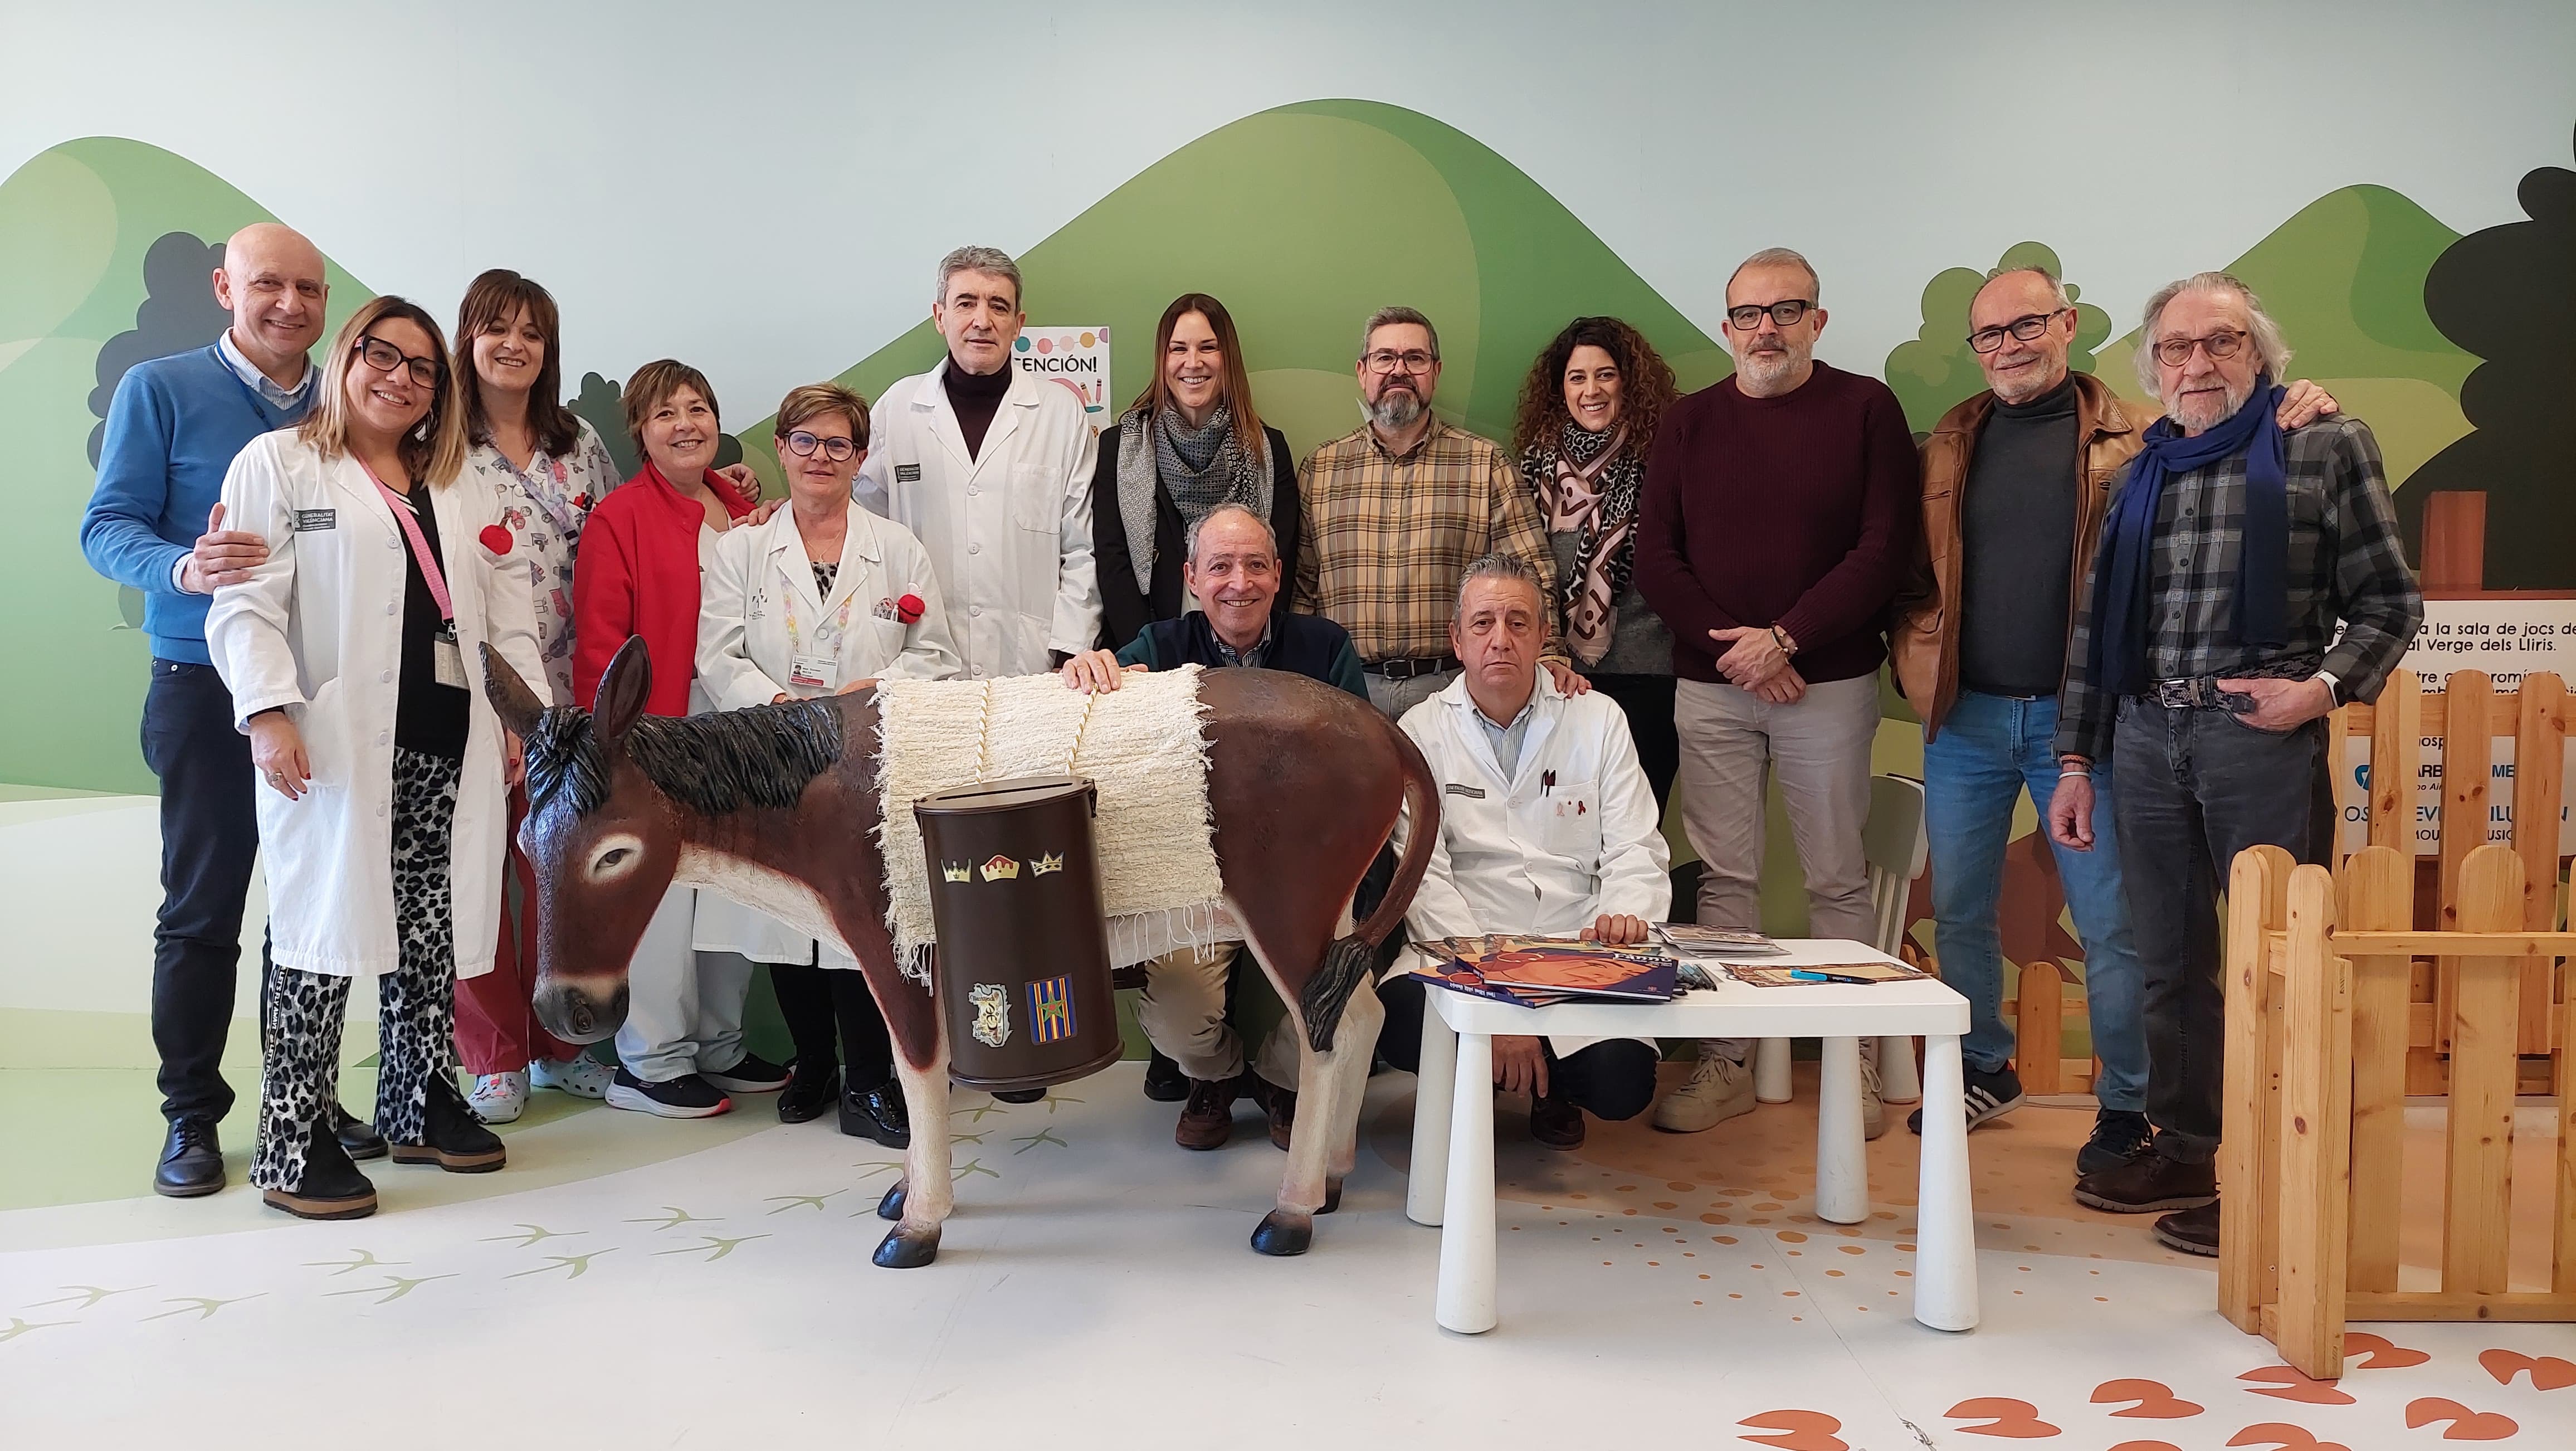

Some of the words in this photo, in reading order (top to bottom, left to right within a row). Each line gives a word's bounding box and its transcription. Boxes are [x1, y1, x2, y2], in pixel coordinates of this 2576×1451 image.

[2437, 622, 2450, 635] la
[2457, 622, 2490, 635] sala
[2496, 622, 2517, 635] de
[2521, 622, 2554, 637] jocs
[2427, 639, 2473, 654] Verge
[2481, 638, 2511, 651] dels
[2519, 638, 2557, 651] Lliris.
[276, 971, 285, 991] LET'S
